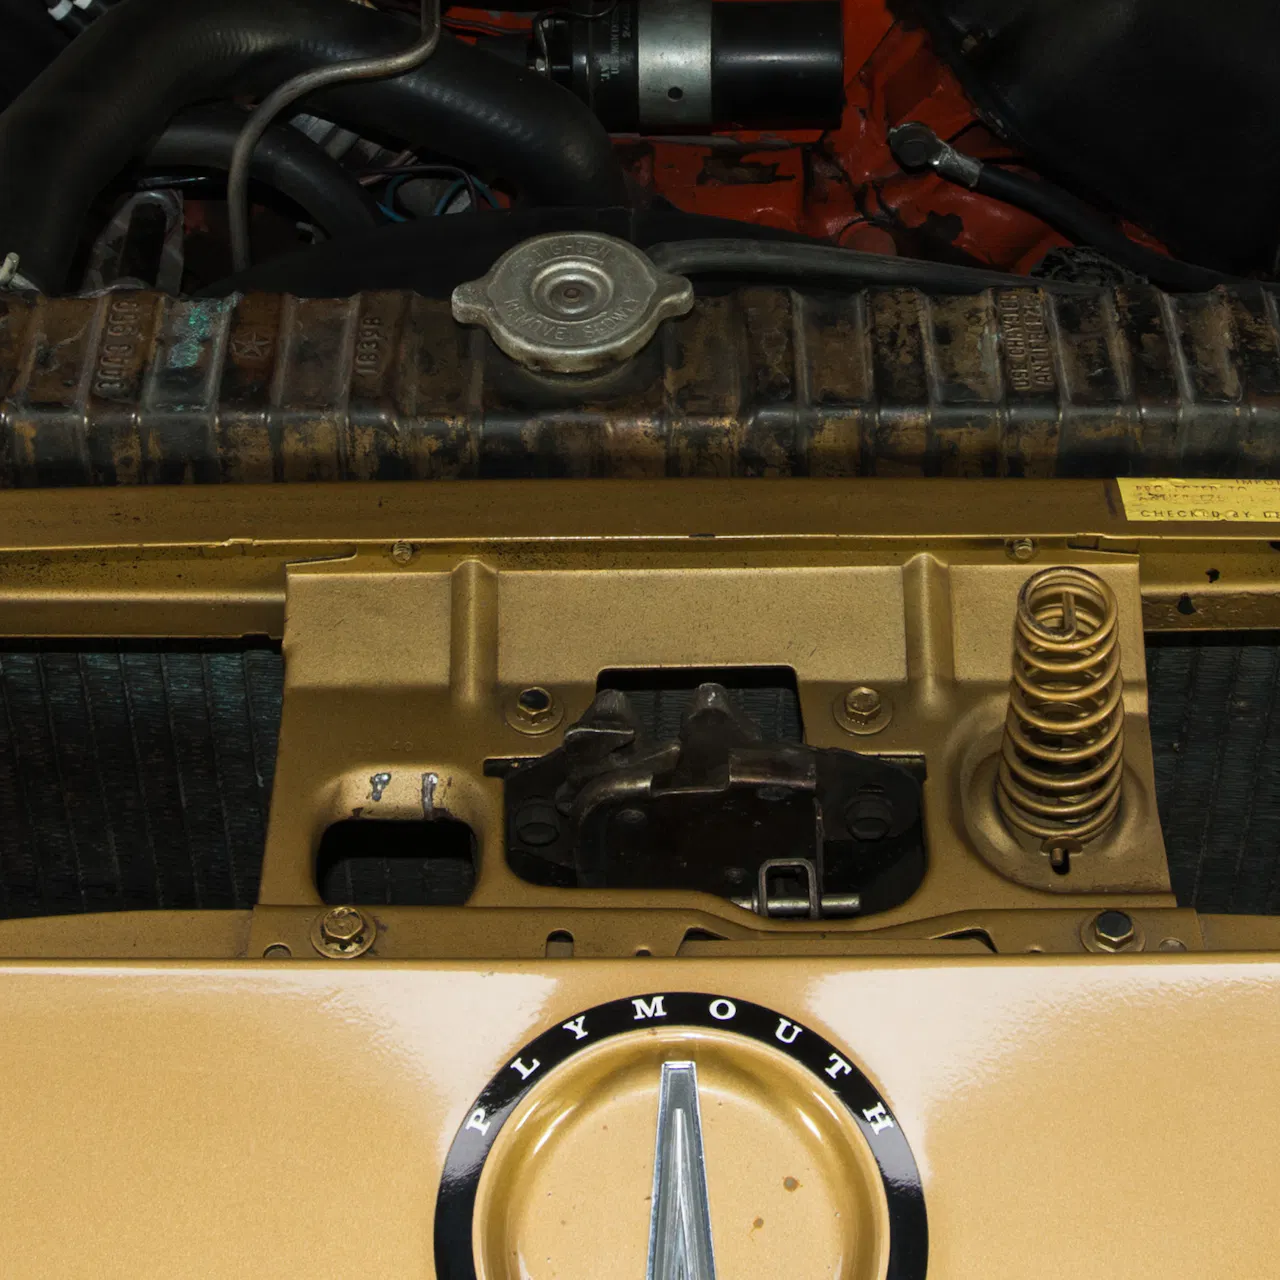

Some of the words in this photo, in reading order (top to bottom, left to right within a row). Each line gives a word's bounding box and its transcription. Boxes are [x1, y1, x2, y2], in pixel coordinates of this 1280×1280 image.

[503, 297, 567, 341] REMOVE
[582, 295, 641, 339] SLOWLY
[464, 995, 895, 1137] PLYMOUTH
